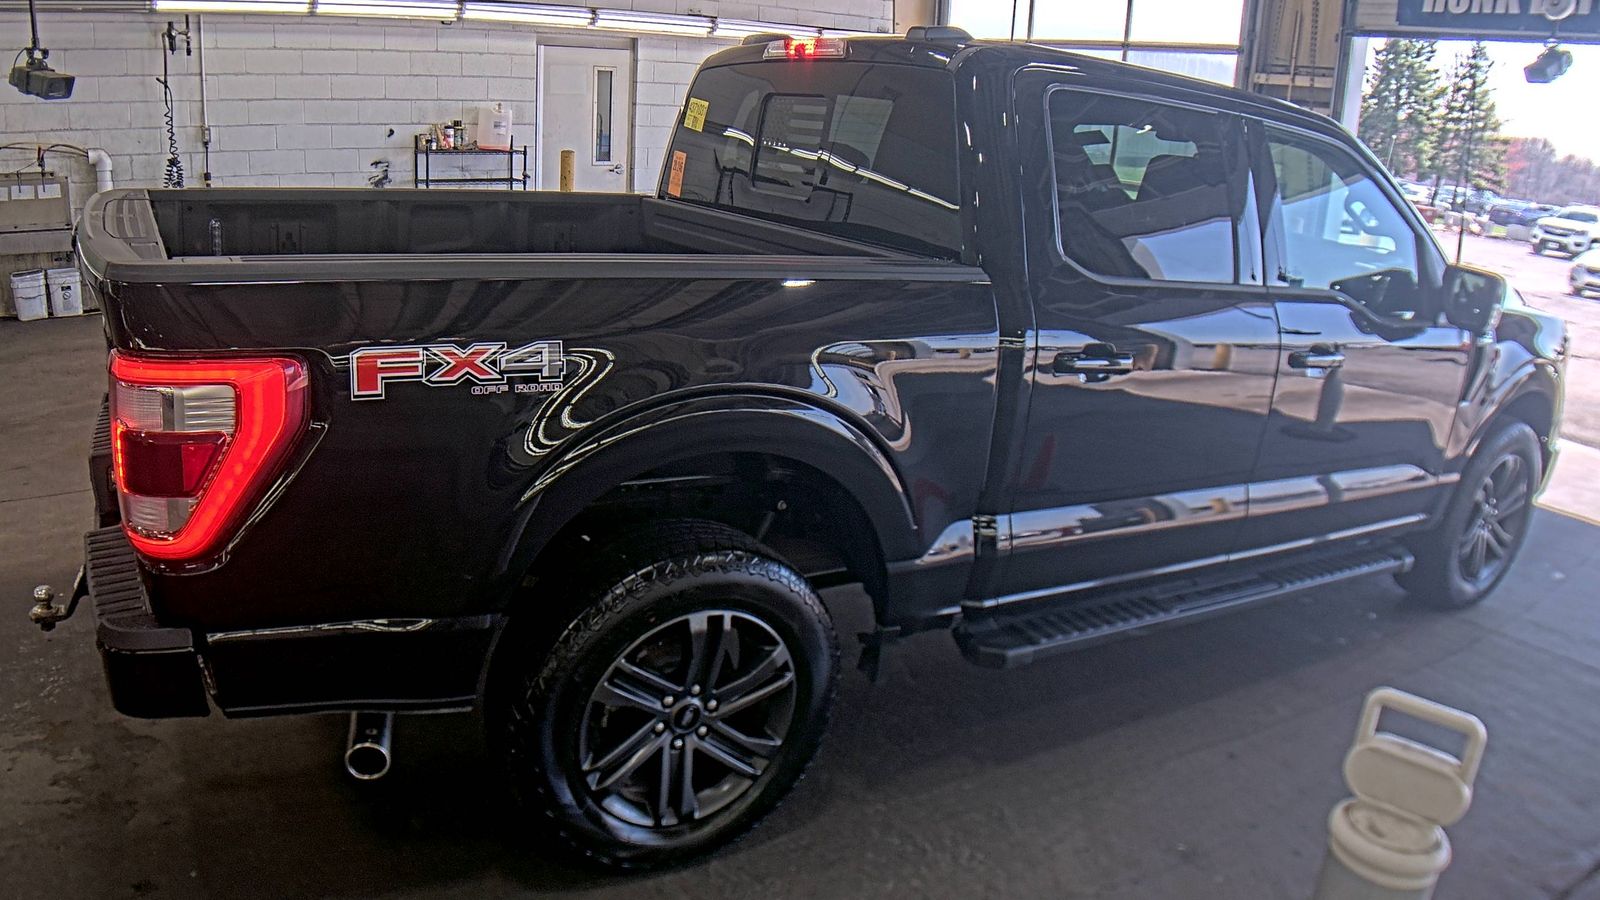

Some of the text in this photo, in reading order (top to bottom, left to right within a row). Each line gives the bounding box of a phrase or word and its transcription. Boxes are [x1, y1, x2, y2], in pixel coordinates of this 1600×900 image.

[349, 341, 566, 401] FX4
[470, 383, 564, 395] OFF ROAD
